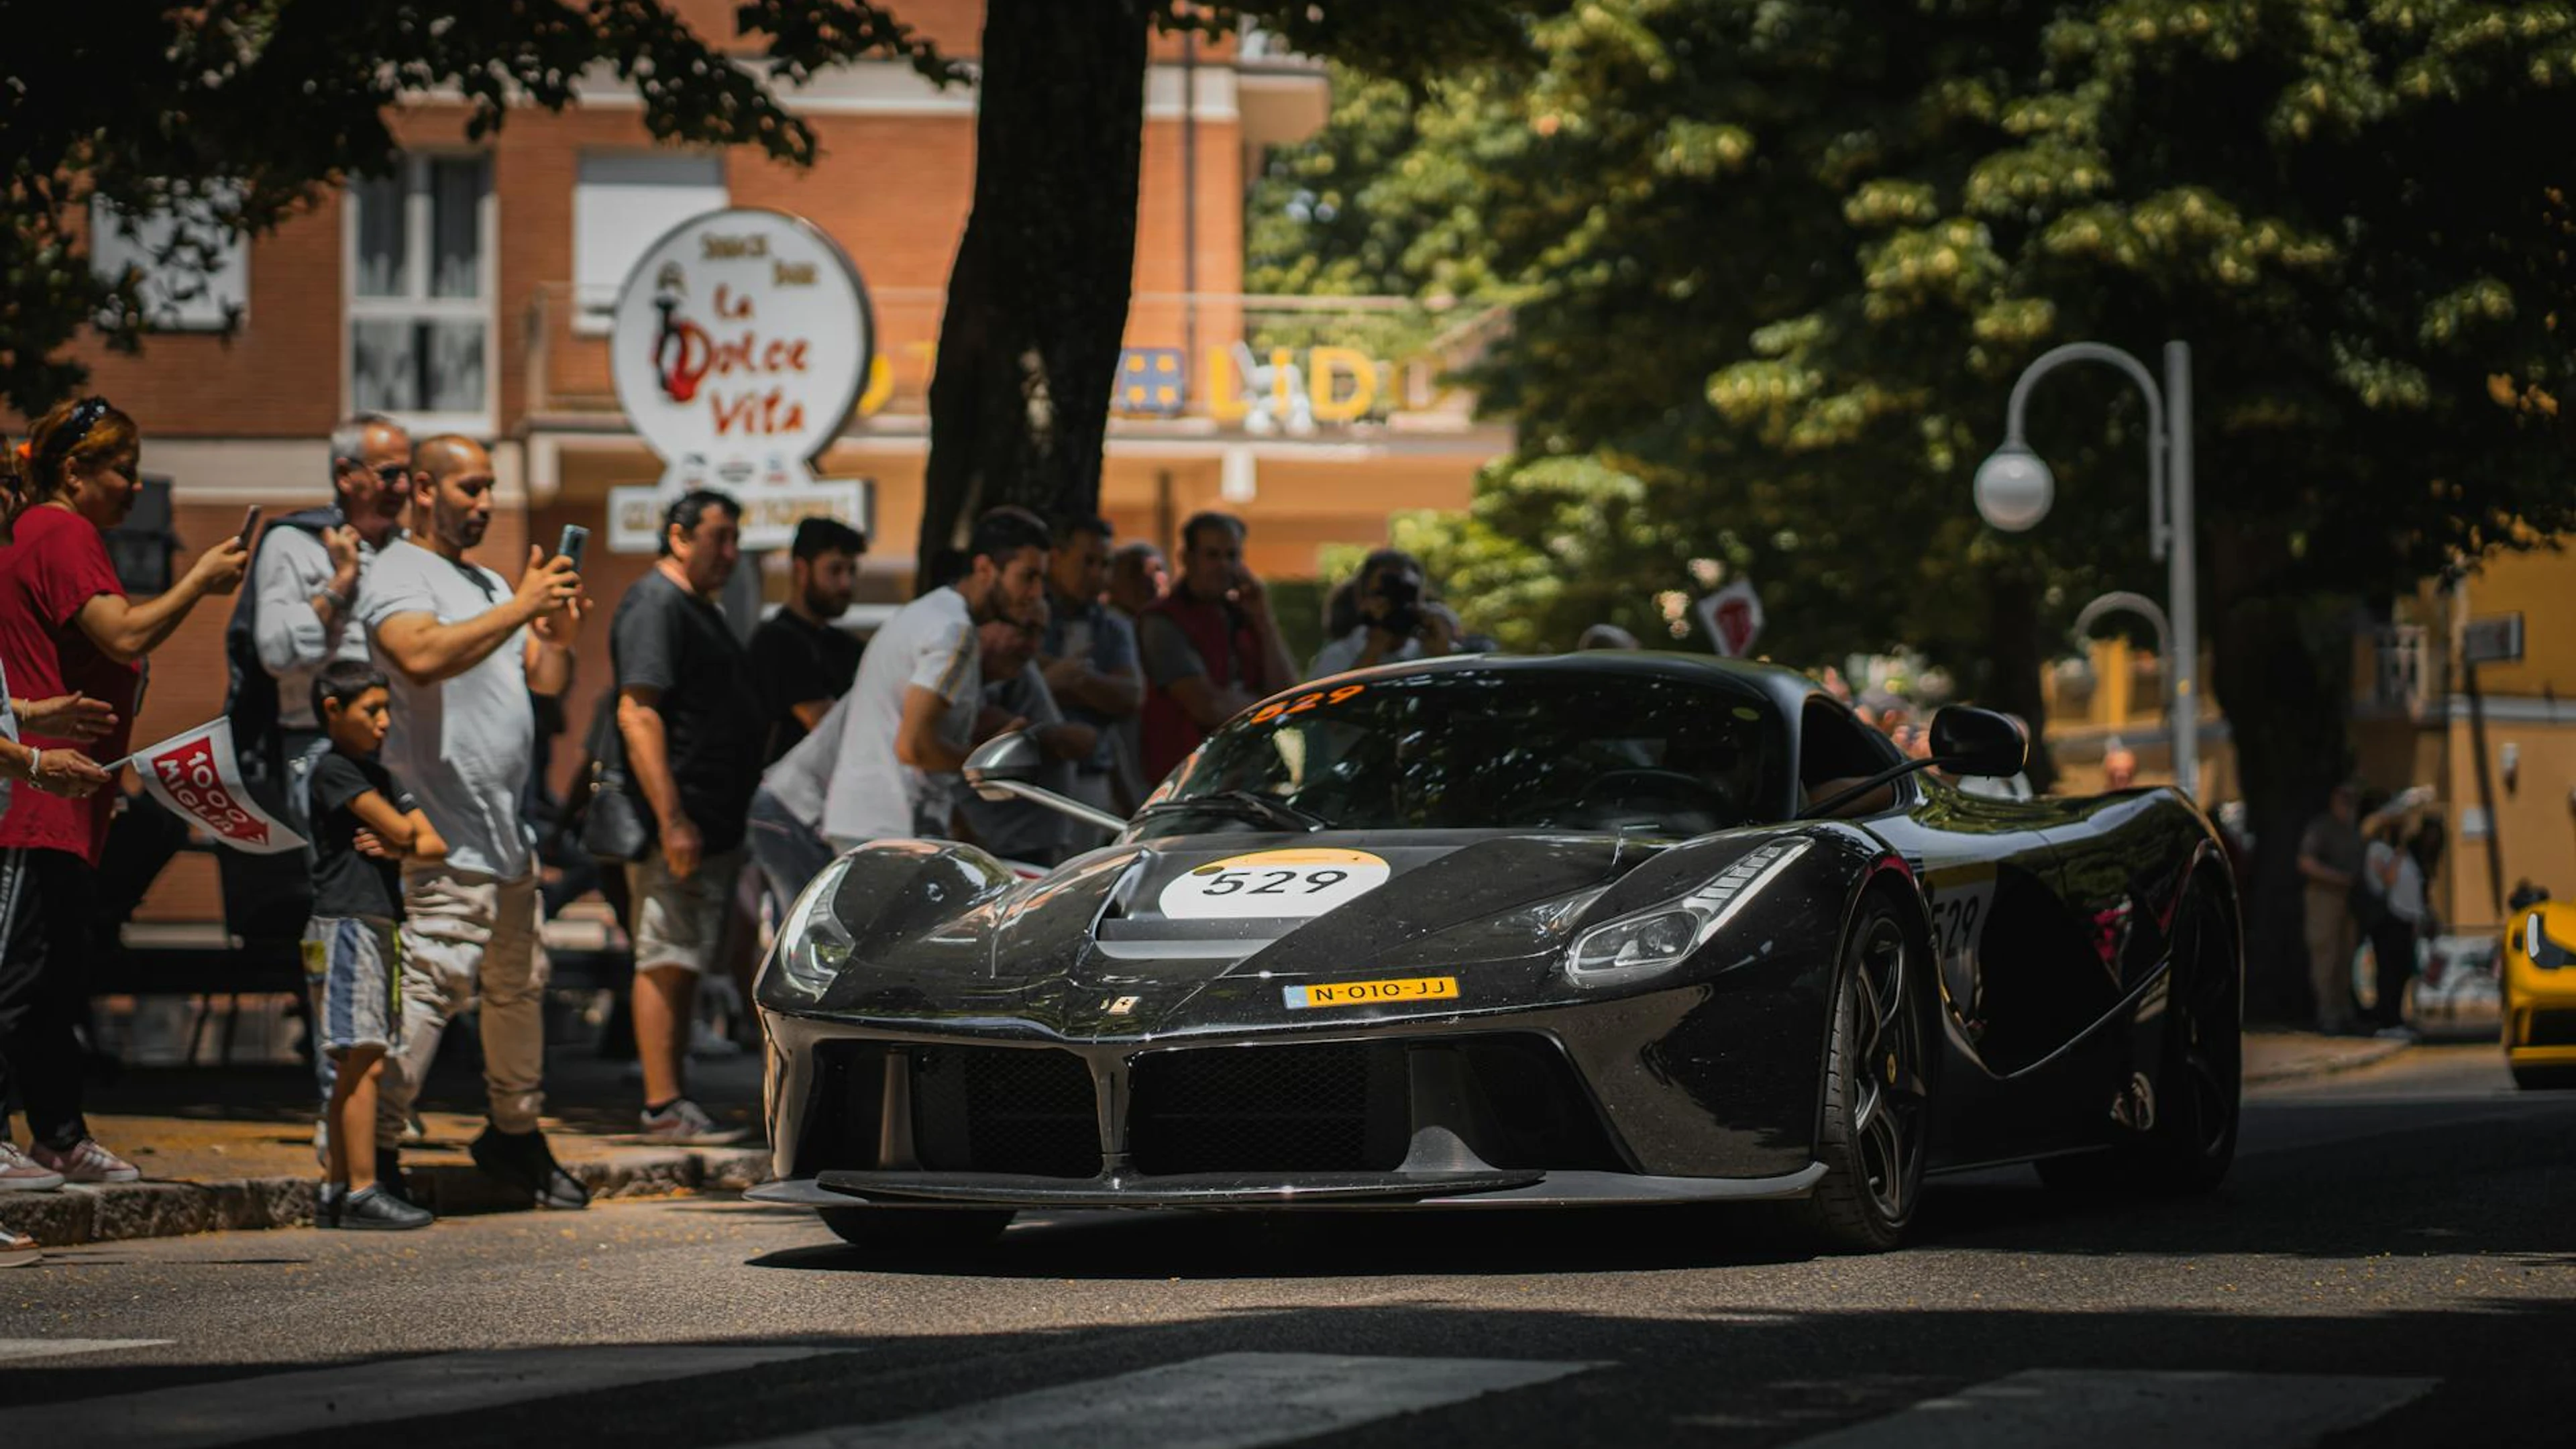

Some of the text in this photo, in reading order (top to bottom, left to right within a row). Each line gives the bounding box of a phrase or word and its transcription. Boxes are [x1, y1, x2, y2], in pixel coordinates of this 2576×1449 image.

[672, 319, 810, 402] Dolce
[711, 390, 804, 436] Vita
[1250, 684, 1366, 725] 529
[157, 759, 234, 834] MIGLIA
[187, 750, 248, 824] 1000
[1202, 869, 1348, 896] 529
[1930, 894, 1980, 960] 529
[1315, 981, 1445, 1002] N-010-JJ
